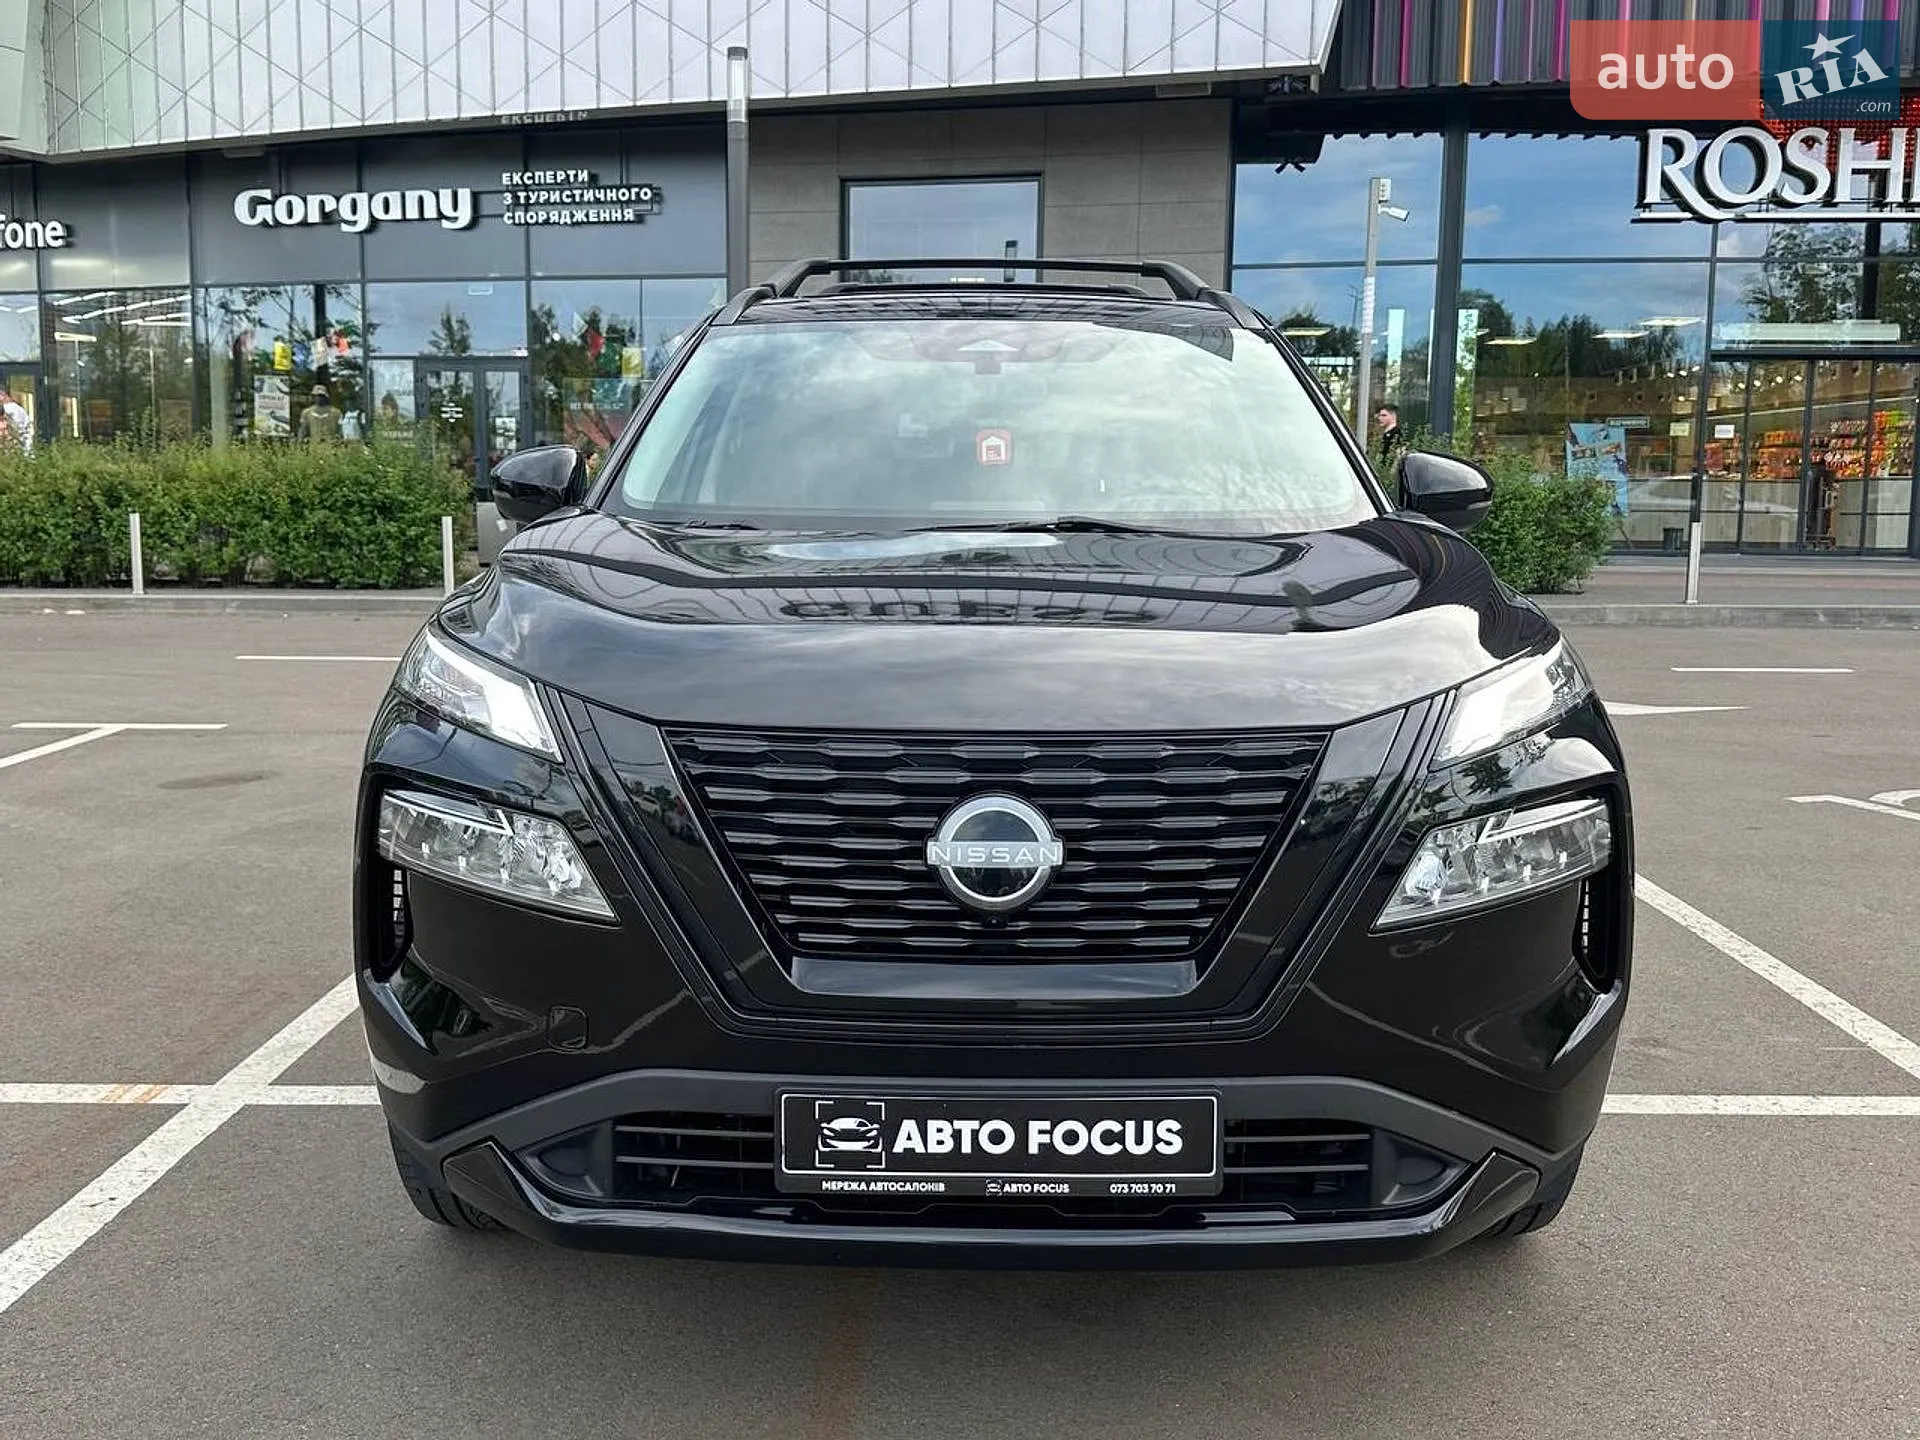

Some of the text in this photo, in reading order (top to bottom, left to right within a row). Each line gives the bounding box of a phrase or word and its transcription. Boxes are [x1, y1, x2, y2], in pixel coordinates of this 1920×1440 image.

[501, 169, 589, 186] ЕКСПЕРТИ
[517, 187, 652, 204] ТУРИСТИЧНОГО
[233, 187, 472, 233] Gorgany
[503, 208, 635, 226] СПОРЯДЖЕННЯ
[931, 845, 1059, 863] NISSAN
[892, 1118, 1183, 1155] АВТО FOCUS
[821, 1180, 946, 1192] МЕРЕЖА АВТОСАЛОНІВ
[1003, 1183, 1070, 1194] АВТО FOCUS
[1109, 1183, 1176, 1194] 073 703 70 71
